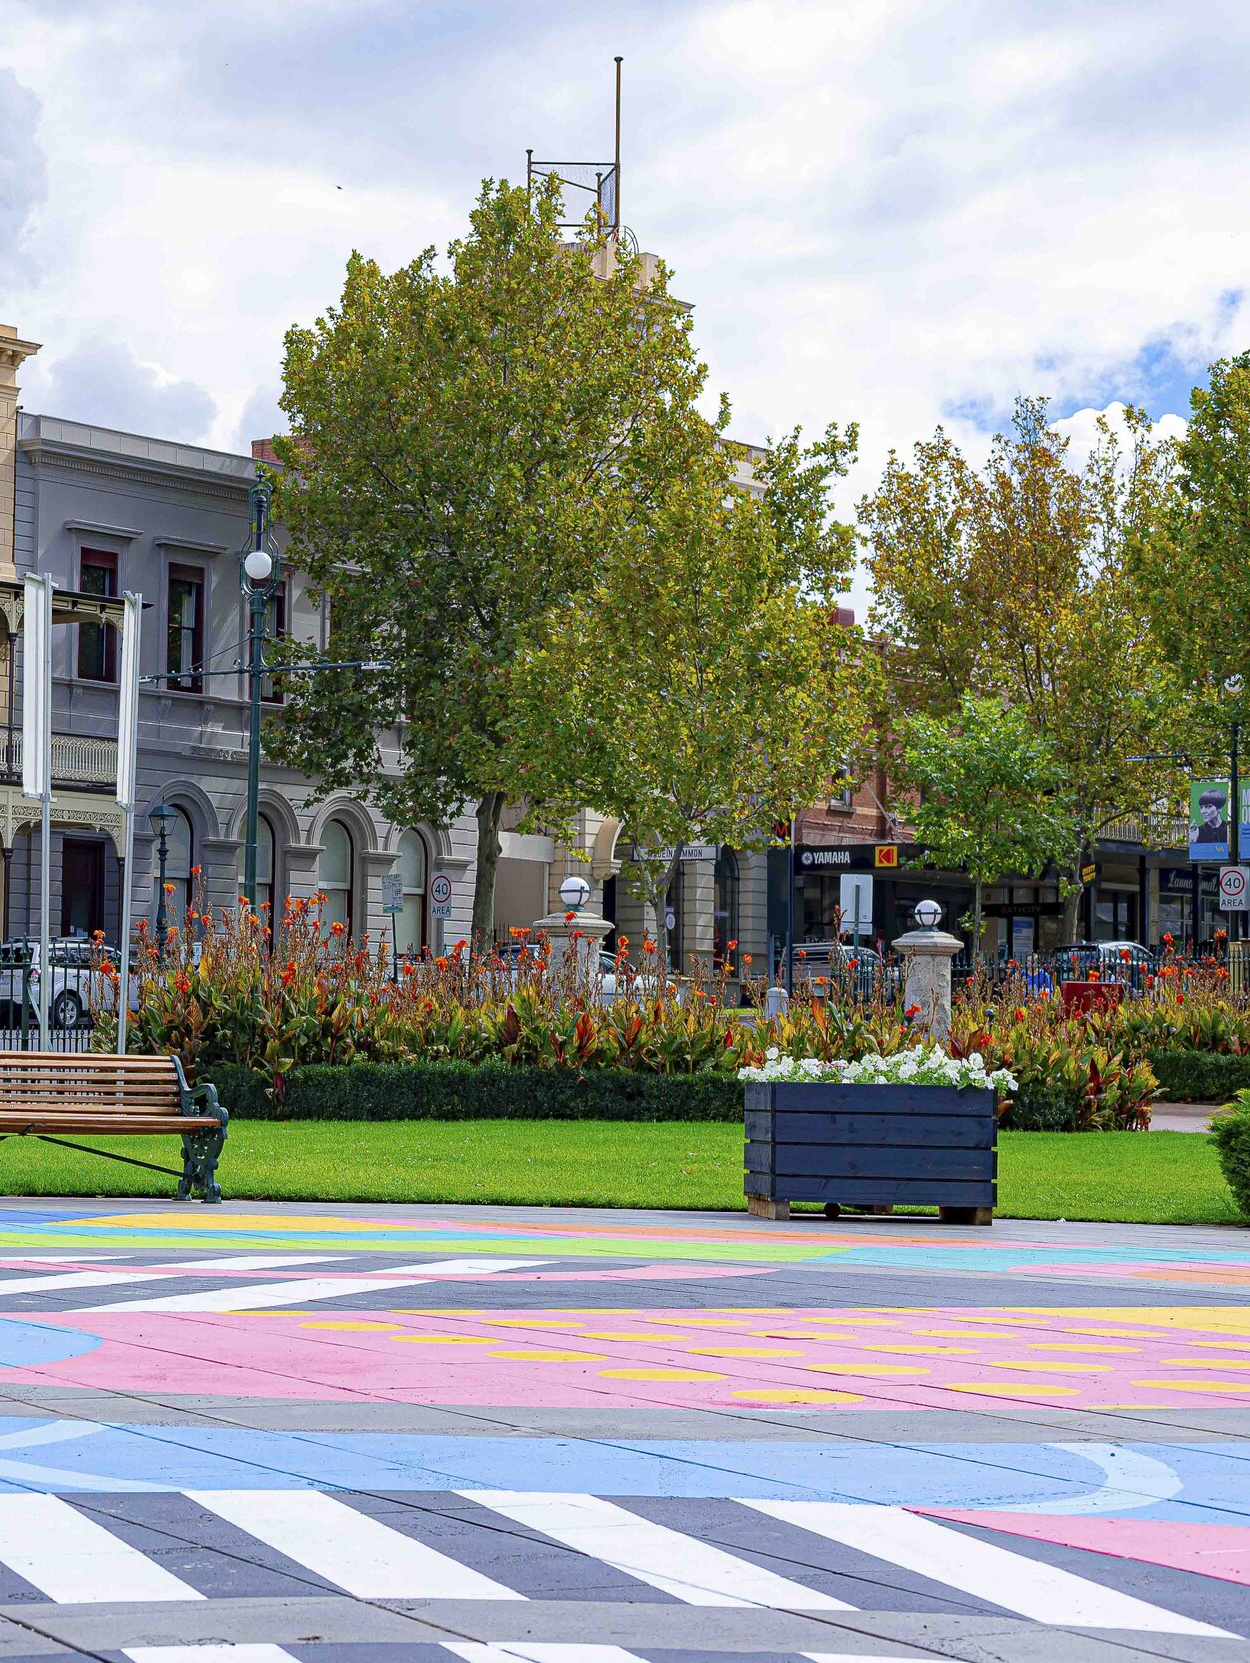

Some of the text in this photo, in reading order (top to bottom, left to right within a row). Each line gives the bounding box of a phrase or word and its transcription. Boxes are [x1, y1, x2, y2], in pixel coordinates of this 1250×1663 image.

[813, 851, 851, 864] YAMAHA
[1224, 877, 1242, 889] 40
[434, 883, 449, 896] 40
[1220, 899, 1244, 907] AREA
[431, 906, 451, 915] AREA
